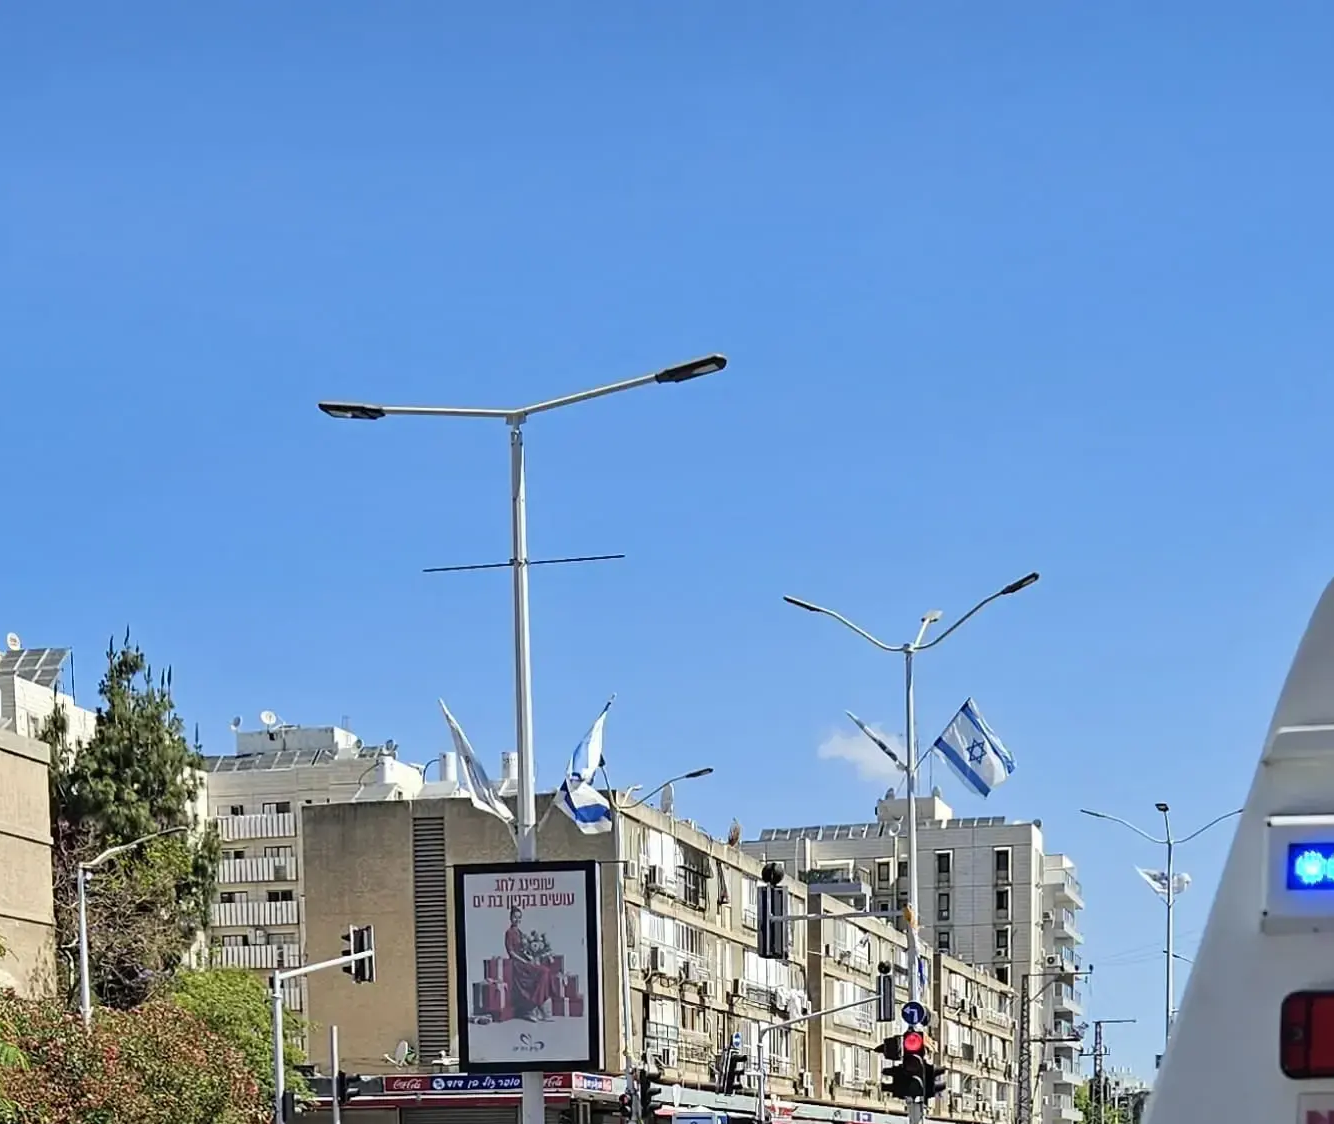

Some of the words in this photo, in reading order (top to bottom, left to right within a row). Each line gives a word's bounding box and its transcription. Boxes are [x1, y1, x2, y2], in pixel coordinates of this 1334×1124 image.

[495, 876, 515, 892] לחג
[518, 877, 555, 891] שופינג
[473, 895, 484, 908] ים
[487, 895, 503, 907] בת
[507, 894, 537, 909] בקניון
[540, 893, 575, 906] עושים
[497, 1077, 521, 1087] סופר
